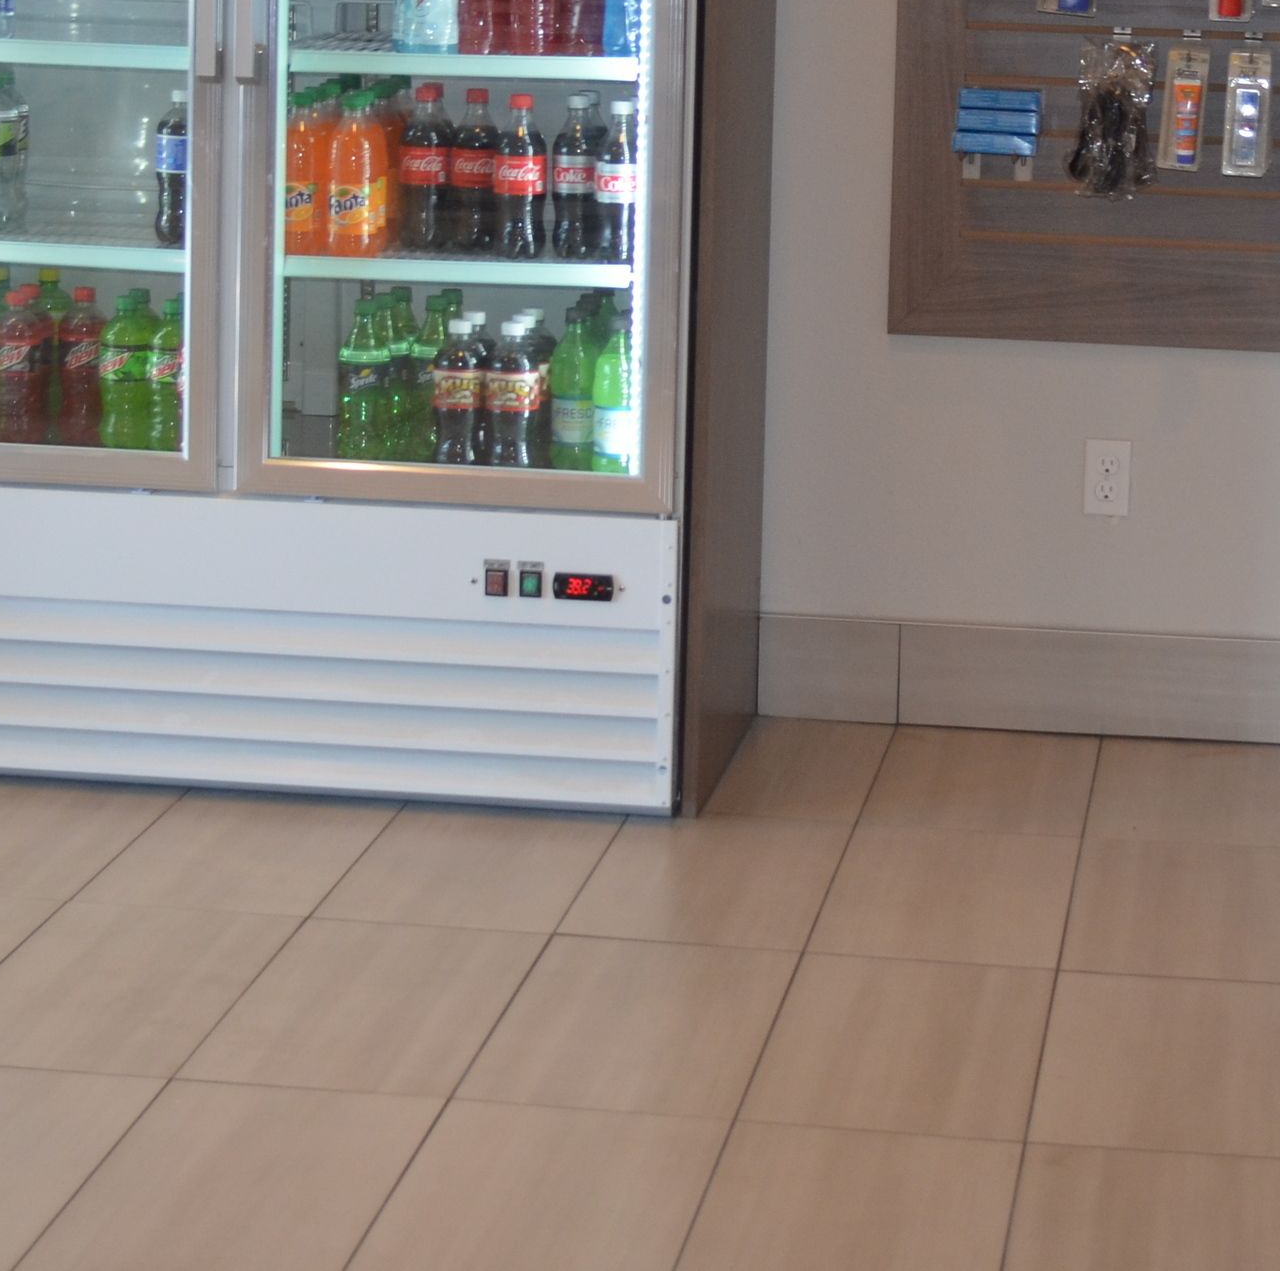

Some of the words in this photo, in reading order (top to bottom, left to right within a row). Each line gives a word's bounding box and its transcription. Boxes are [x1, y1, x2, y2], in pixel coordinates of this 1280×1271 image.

[401, 156, 443, 172] Coca-Cola
[499, 165, 542, 181] Coca-Cola
[554, 168, 587, 184] Coke
[328, 191, 367, 216] Fanta
[488, 380, 528, 397] MUG
